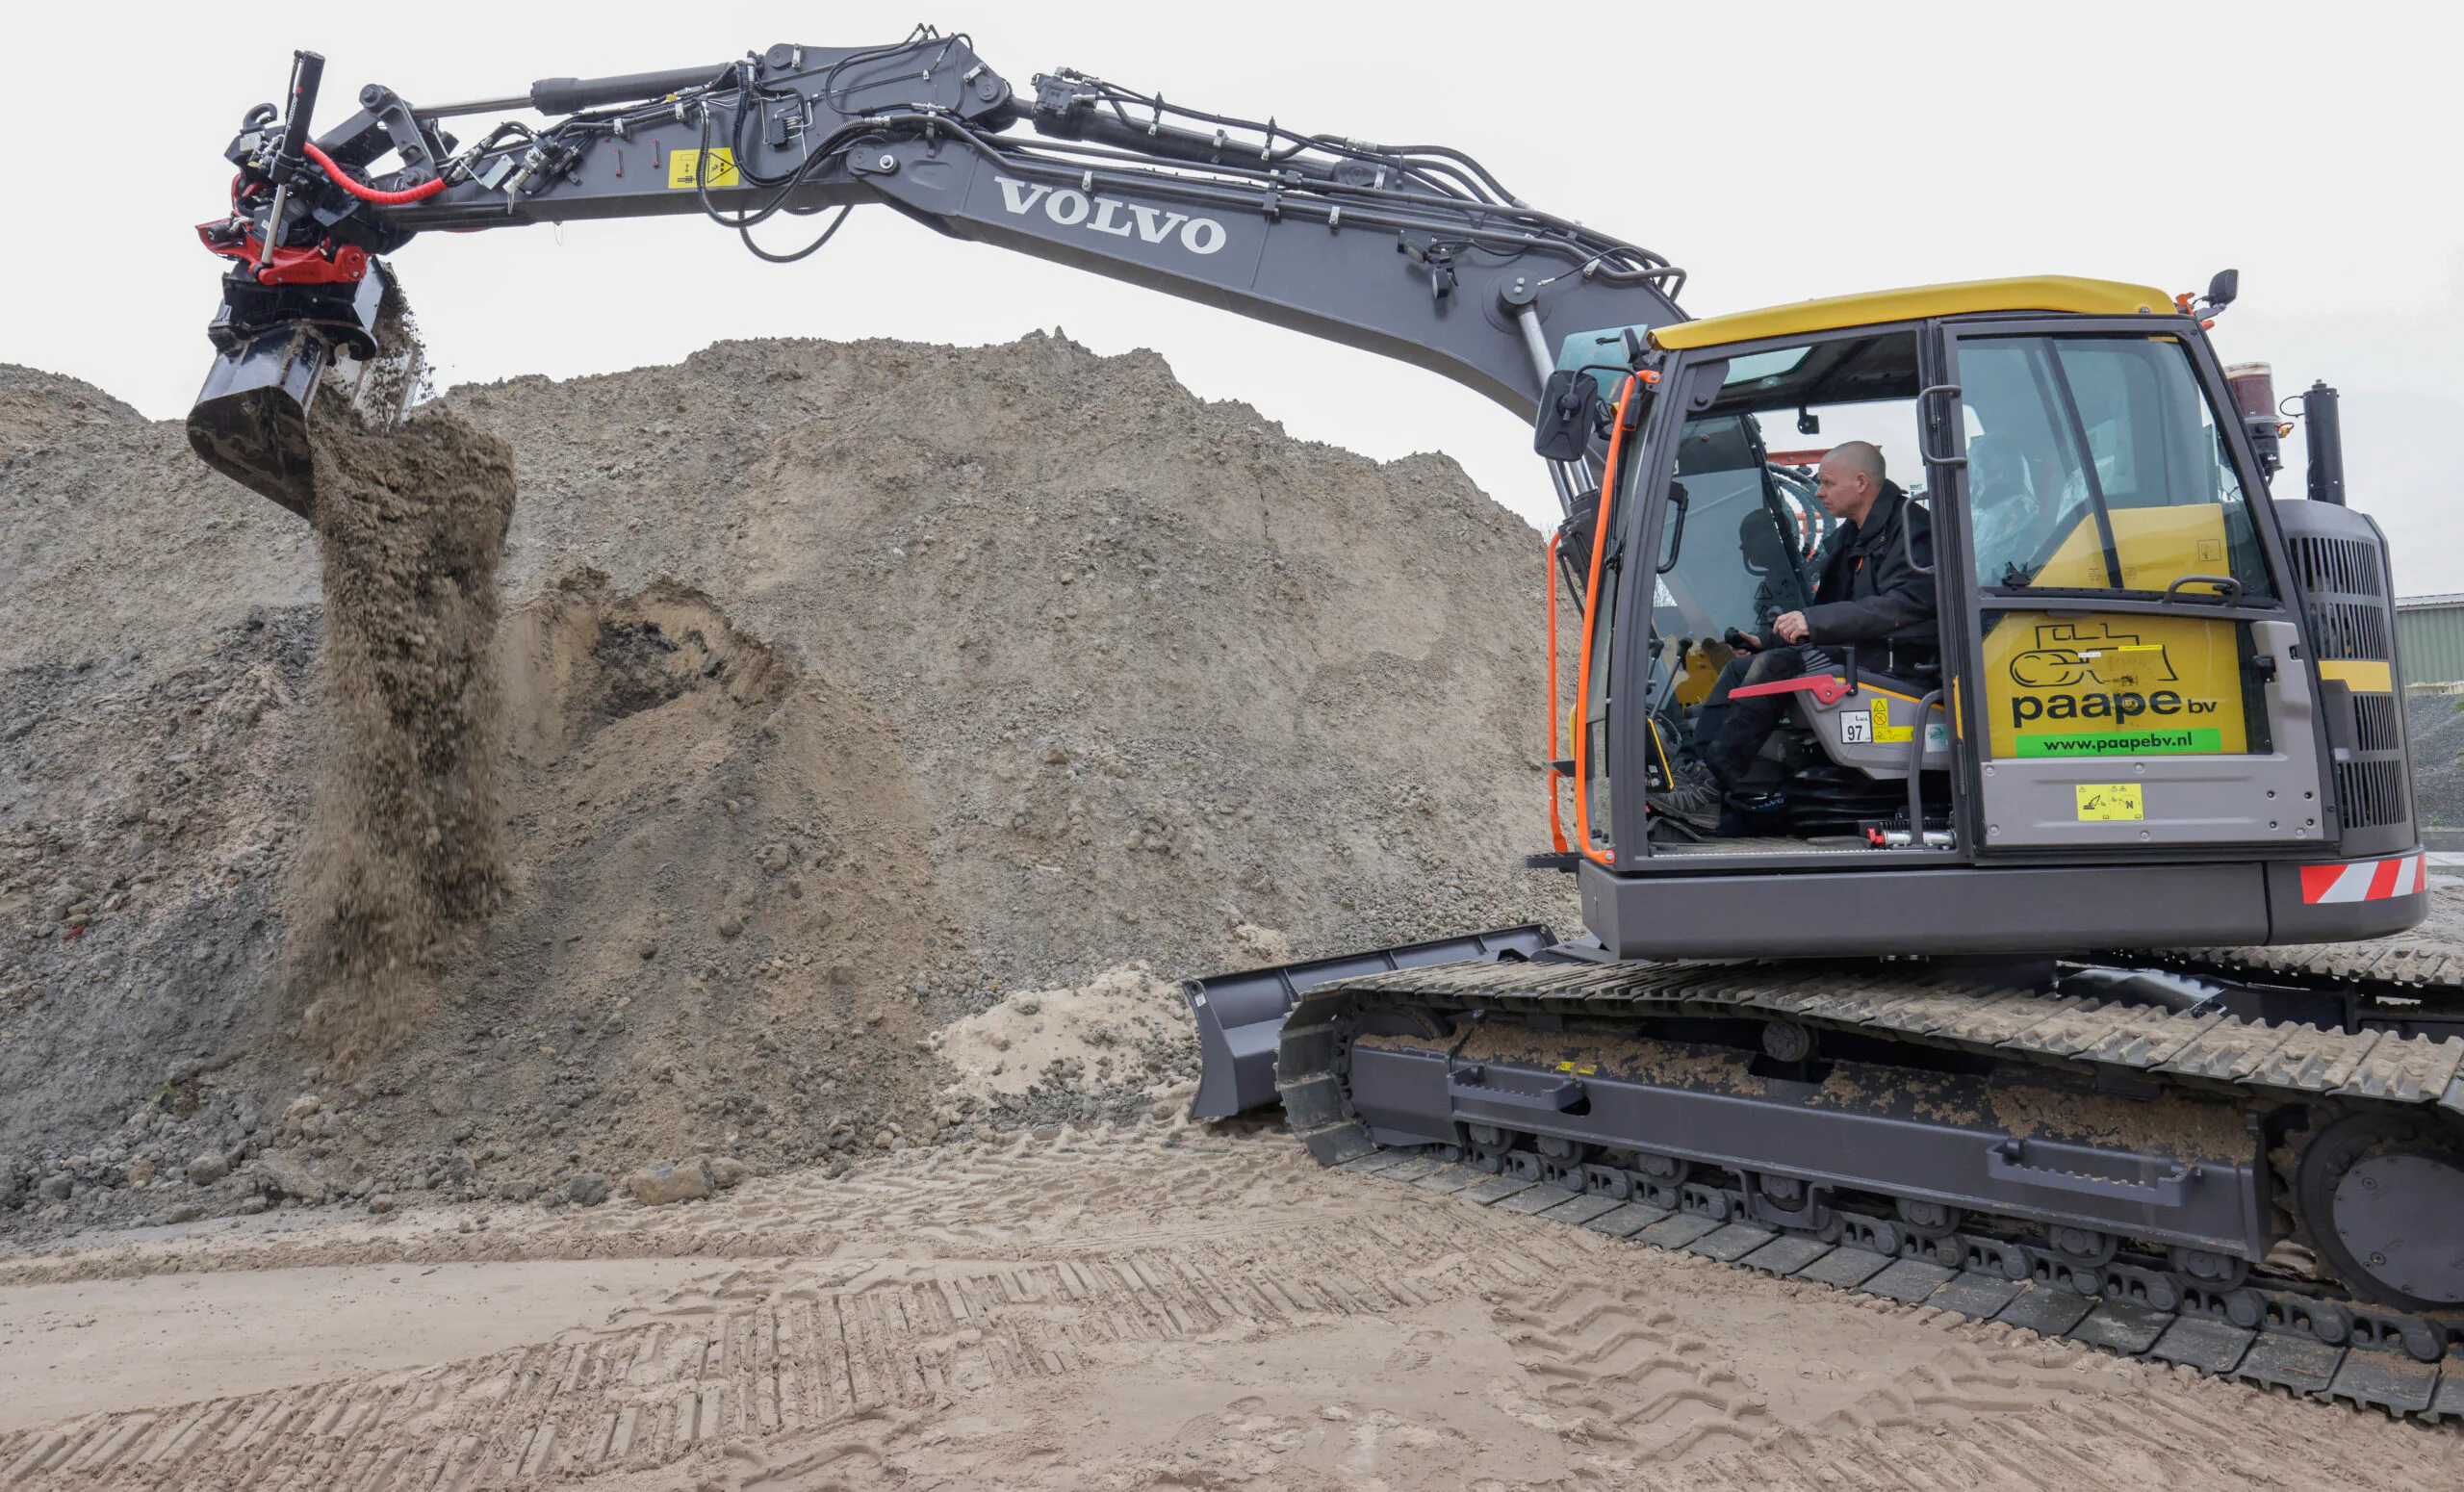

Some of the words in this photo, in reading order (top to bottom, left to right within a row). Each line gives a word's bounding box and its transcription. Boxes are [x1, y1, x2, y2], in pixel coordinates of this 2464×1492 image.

[994, 176, 1226, 254] VOLVO
[2012, 689, 2182, 728] paape
[2188, 699, 2217, 713] bv
[1847, 726, 1862, 740] 97
[2043, 732, 2193, 752] www.paapebv.nl
